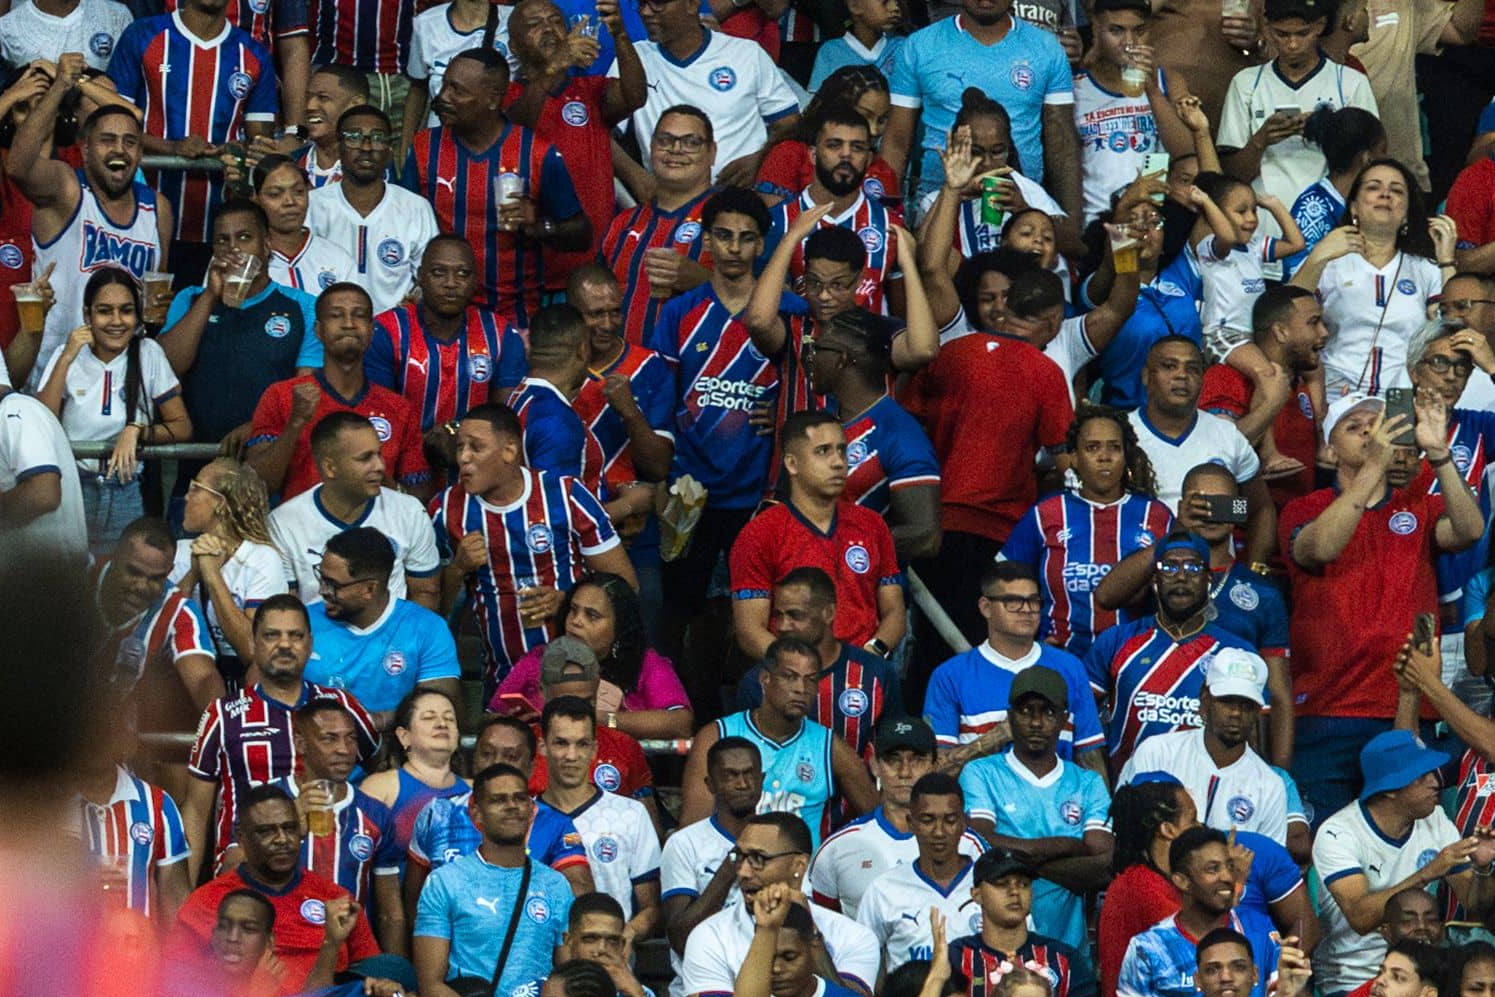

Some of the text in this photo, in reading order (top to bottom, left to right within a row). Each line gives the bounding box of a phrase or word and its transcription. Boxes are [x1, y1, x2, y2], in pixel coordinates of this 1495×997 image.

[80, 219, 156, 280] BAMO
[710, 391, 754, 414] Sort
[1062, 562, 1113, 578] Espo
[1134, 692, 1201, 711] Esporte
